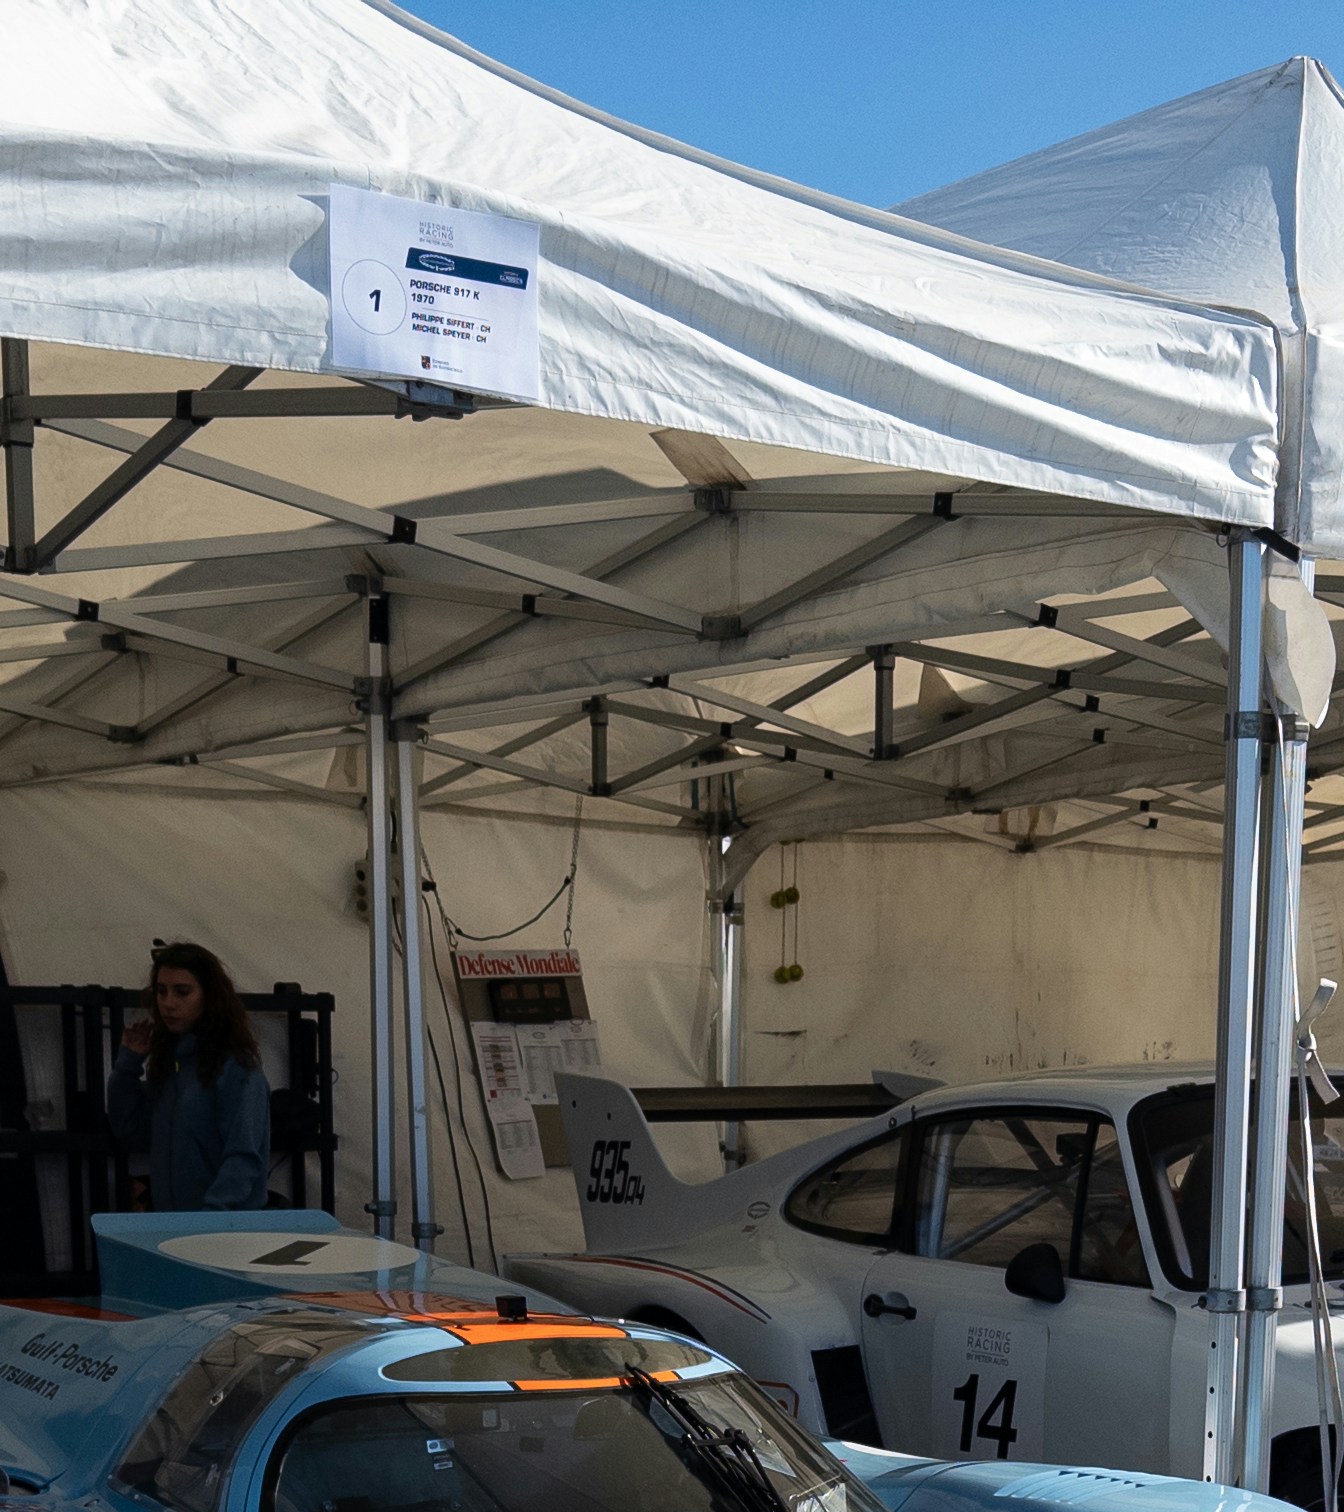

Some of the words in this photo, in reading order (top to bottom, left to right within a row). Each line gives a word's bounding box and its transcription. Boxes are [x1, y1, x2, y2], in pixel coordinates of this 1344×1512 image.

[419, 221, 454, 233] HISTORIC
[419, 229, 454, 241] RACING
[410, 279, 451, 294] PORSCHE
[454, 286, 471, 299] 917
[473, 290, 480, 300] K
[411, 293, 435, 304] 1970
[369, 289, 381, 312] 1
[411, 312, 444, 325] PHILIPPE
[446, 318, 475, 330] SIFFERT
[480, 325, 491, 333] CH
[412, 323, 440, 335] MICHEL
[442, 328, 470, 340] SPEYER
[476, 335, 487, 343] CH
[459, 952, 516, 977] Defense
[516, 951, 580, 975] Mondiale
[249, 1241, 330, 1266] 1
[967, 1326, 1012, 1342] HISTORIC
[967, 1336, 1011, 1354] RACING
[21, 1333, 118, 1382] Gulf-Porsche
[974, 1354, 993, 1364] PETER
[993, 1357, 1009, 1366] AUTO
[953, 1374, 1017, 1459] 14
